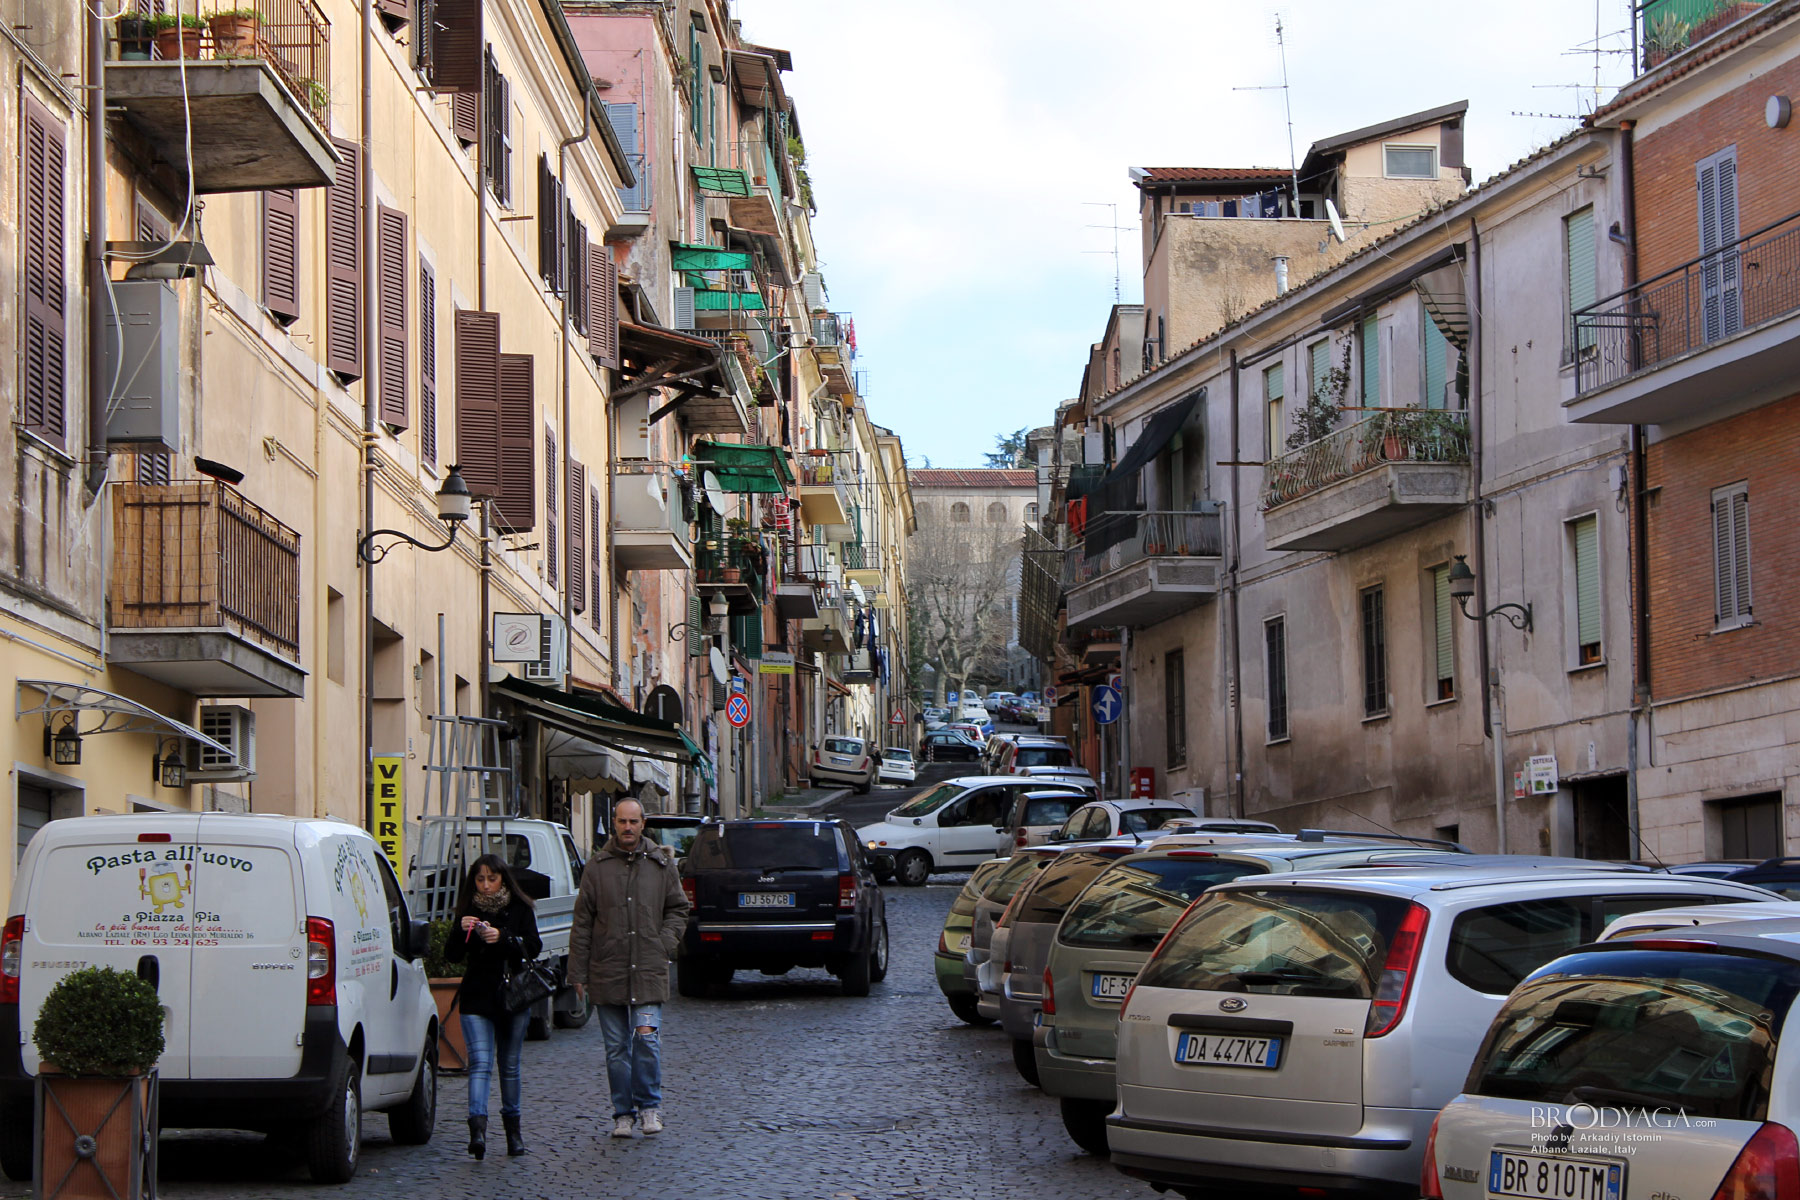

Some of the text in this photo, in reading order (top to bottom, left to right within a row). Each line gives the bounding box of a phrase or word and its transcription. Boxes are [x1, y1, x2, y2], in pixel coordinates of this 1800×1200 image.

[949, 692, 957, 702] P
[86, 845, 253, 876] Pasta all'uovo
[745, 894, 757, 905] DJ
[122, 911, 221, 923] a Piazza Pia
[95, 922, 106, 931] la
[131, 922, 161, 931] buona
[173, 922, 190, 931] che
[31, 961, 88, 969] PEUGEOT
[1101, 976, 1117, 995] CF
[1187, 1037, 1207, 1062] DA
[1213, 1038, 1267, 1065] 447KZ
[1503, 1157, 1529, 1192] BR
[1536, 1161, 1605, 1200] 810TM
